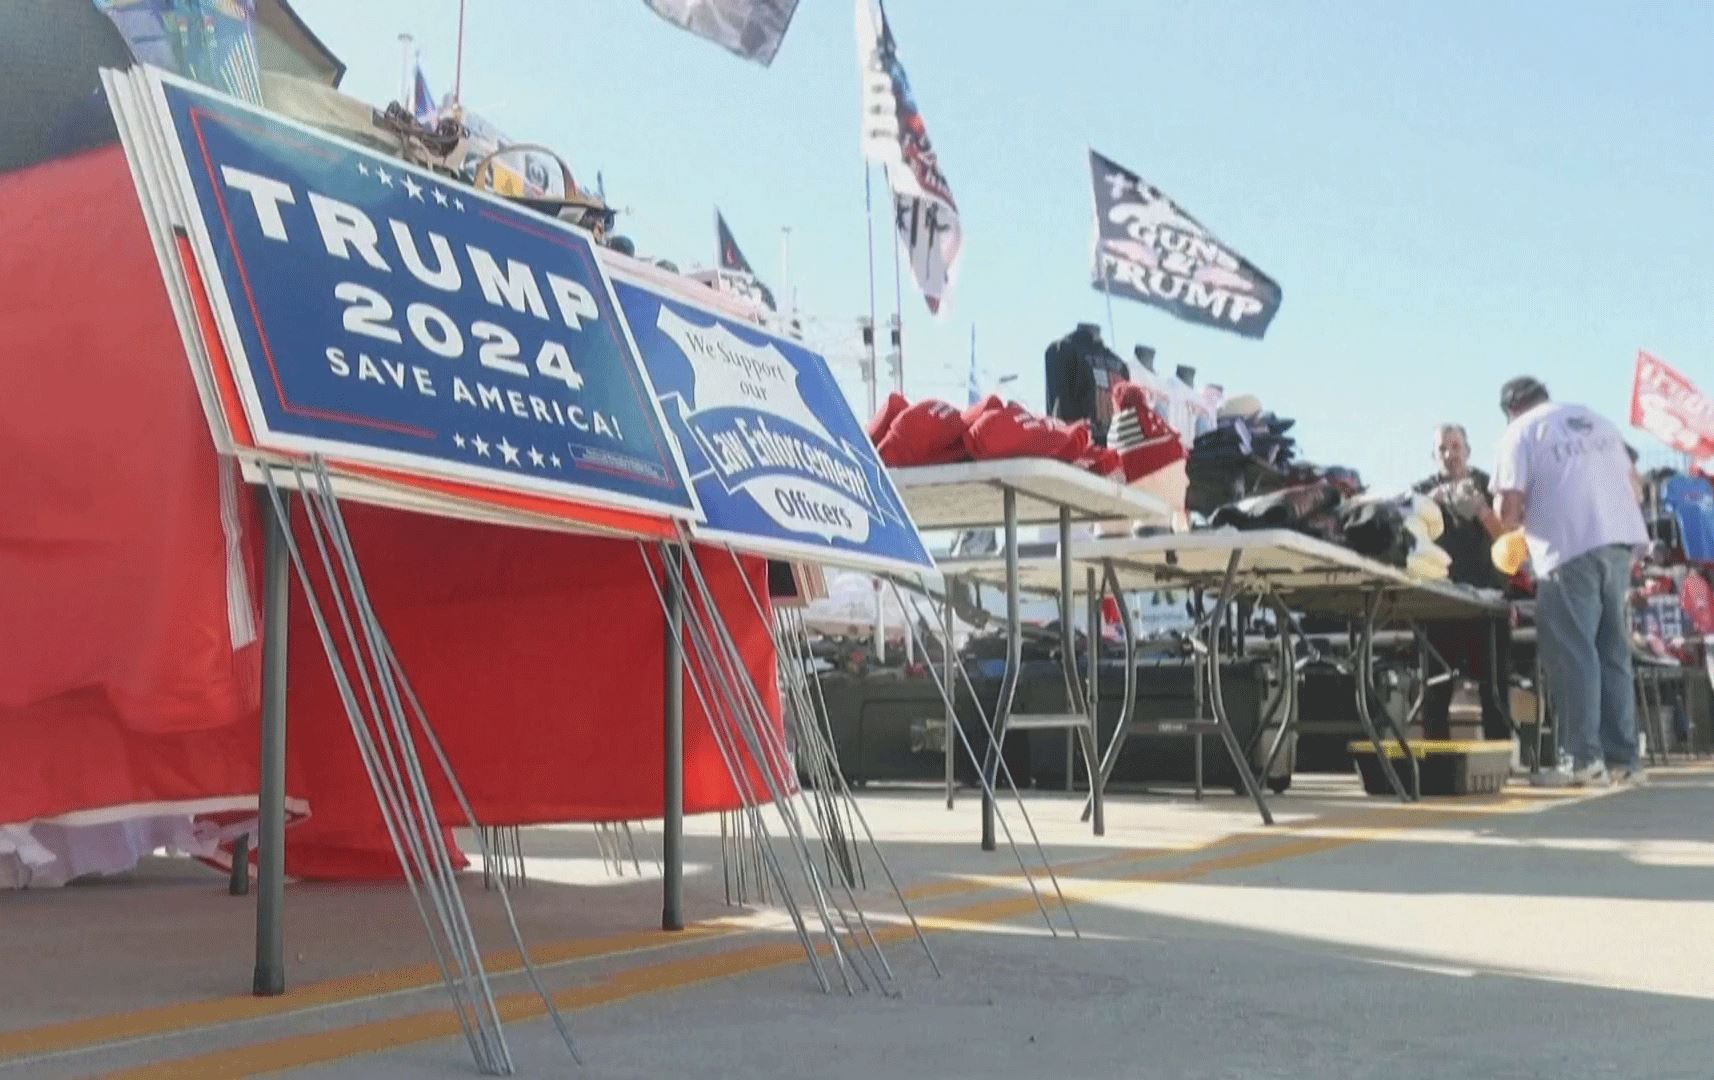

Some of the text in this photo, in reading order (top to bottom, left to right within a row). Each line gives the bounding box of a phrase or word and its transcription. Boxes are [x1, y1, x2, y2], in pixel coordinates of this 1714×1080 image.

[220, 164, 600, 332] TRUMP
[334, 281, 584, 391] 2024
[686, 331, 786, 381] We Support
[325, 346, 623, 441] SAVE AMERICA!
[740, 380, 768, 401] our
[695, 424, 754, 476] Law
[734, 416, 872, 507] Enforcement
[774, 487, 853, 529] Officers
